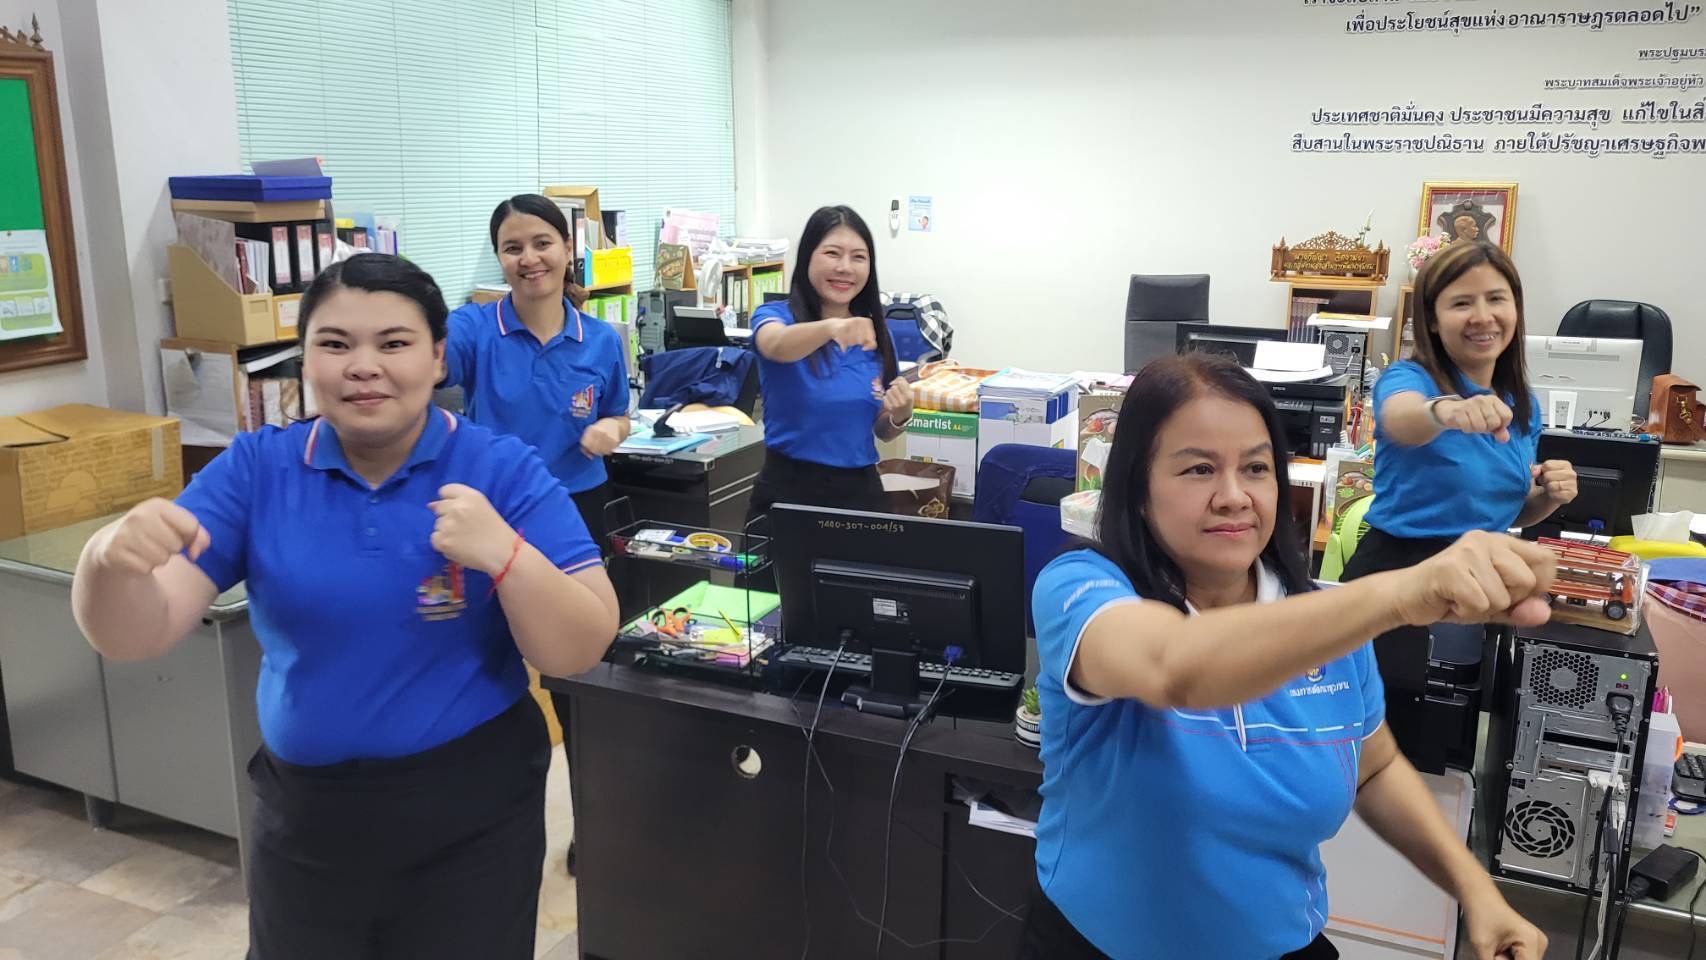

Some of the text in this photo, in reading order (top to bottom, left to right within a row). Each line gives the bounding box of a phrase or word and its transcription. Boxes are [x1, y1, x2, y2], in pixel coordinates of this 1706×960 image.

[1638, 46, 1706, 61] พระปฐมบร
[1544, 73, 1704, 89] พระบาทสมเด็จพระเจ้าอยู่หัว
[1311, 102, 1445, 124] ประเทศชาติมั่นคง
[1449, 103, 1611, 127] ประชาชนมีความสุข
[1291, 132, 1485, 151] สืบสานในพระราชปณิธาน
